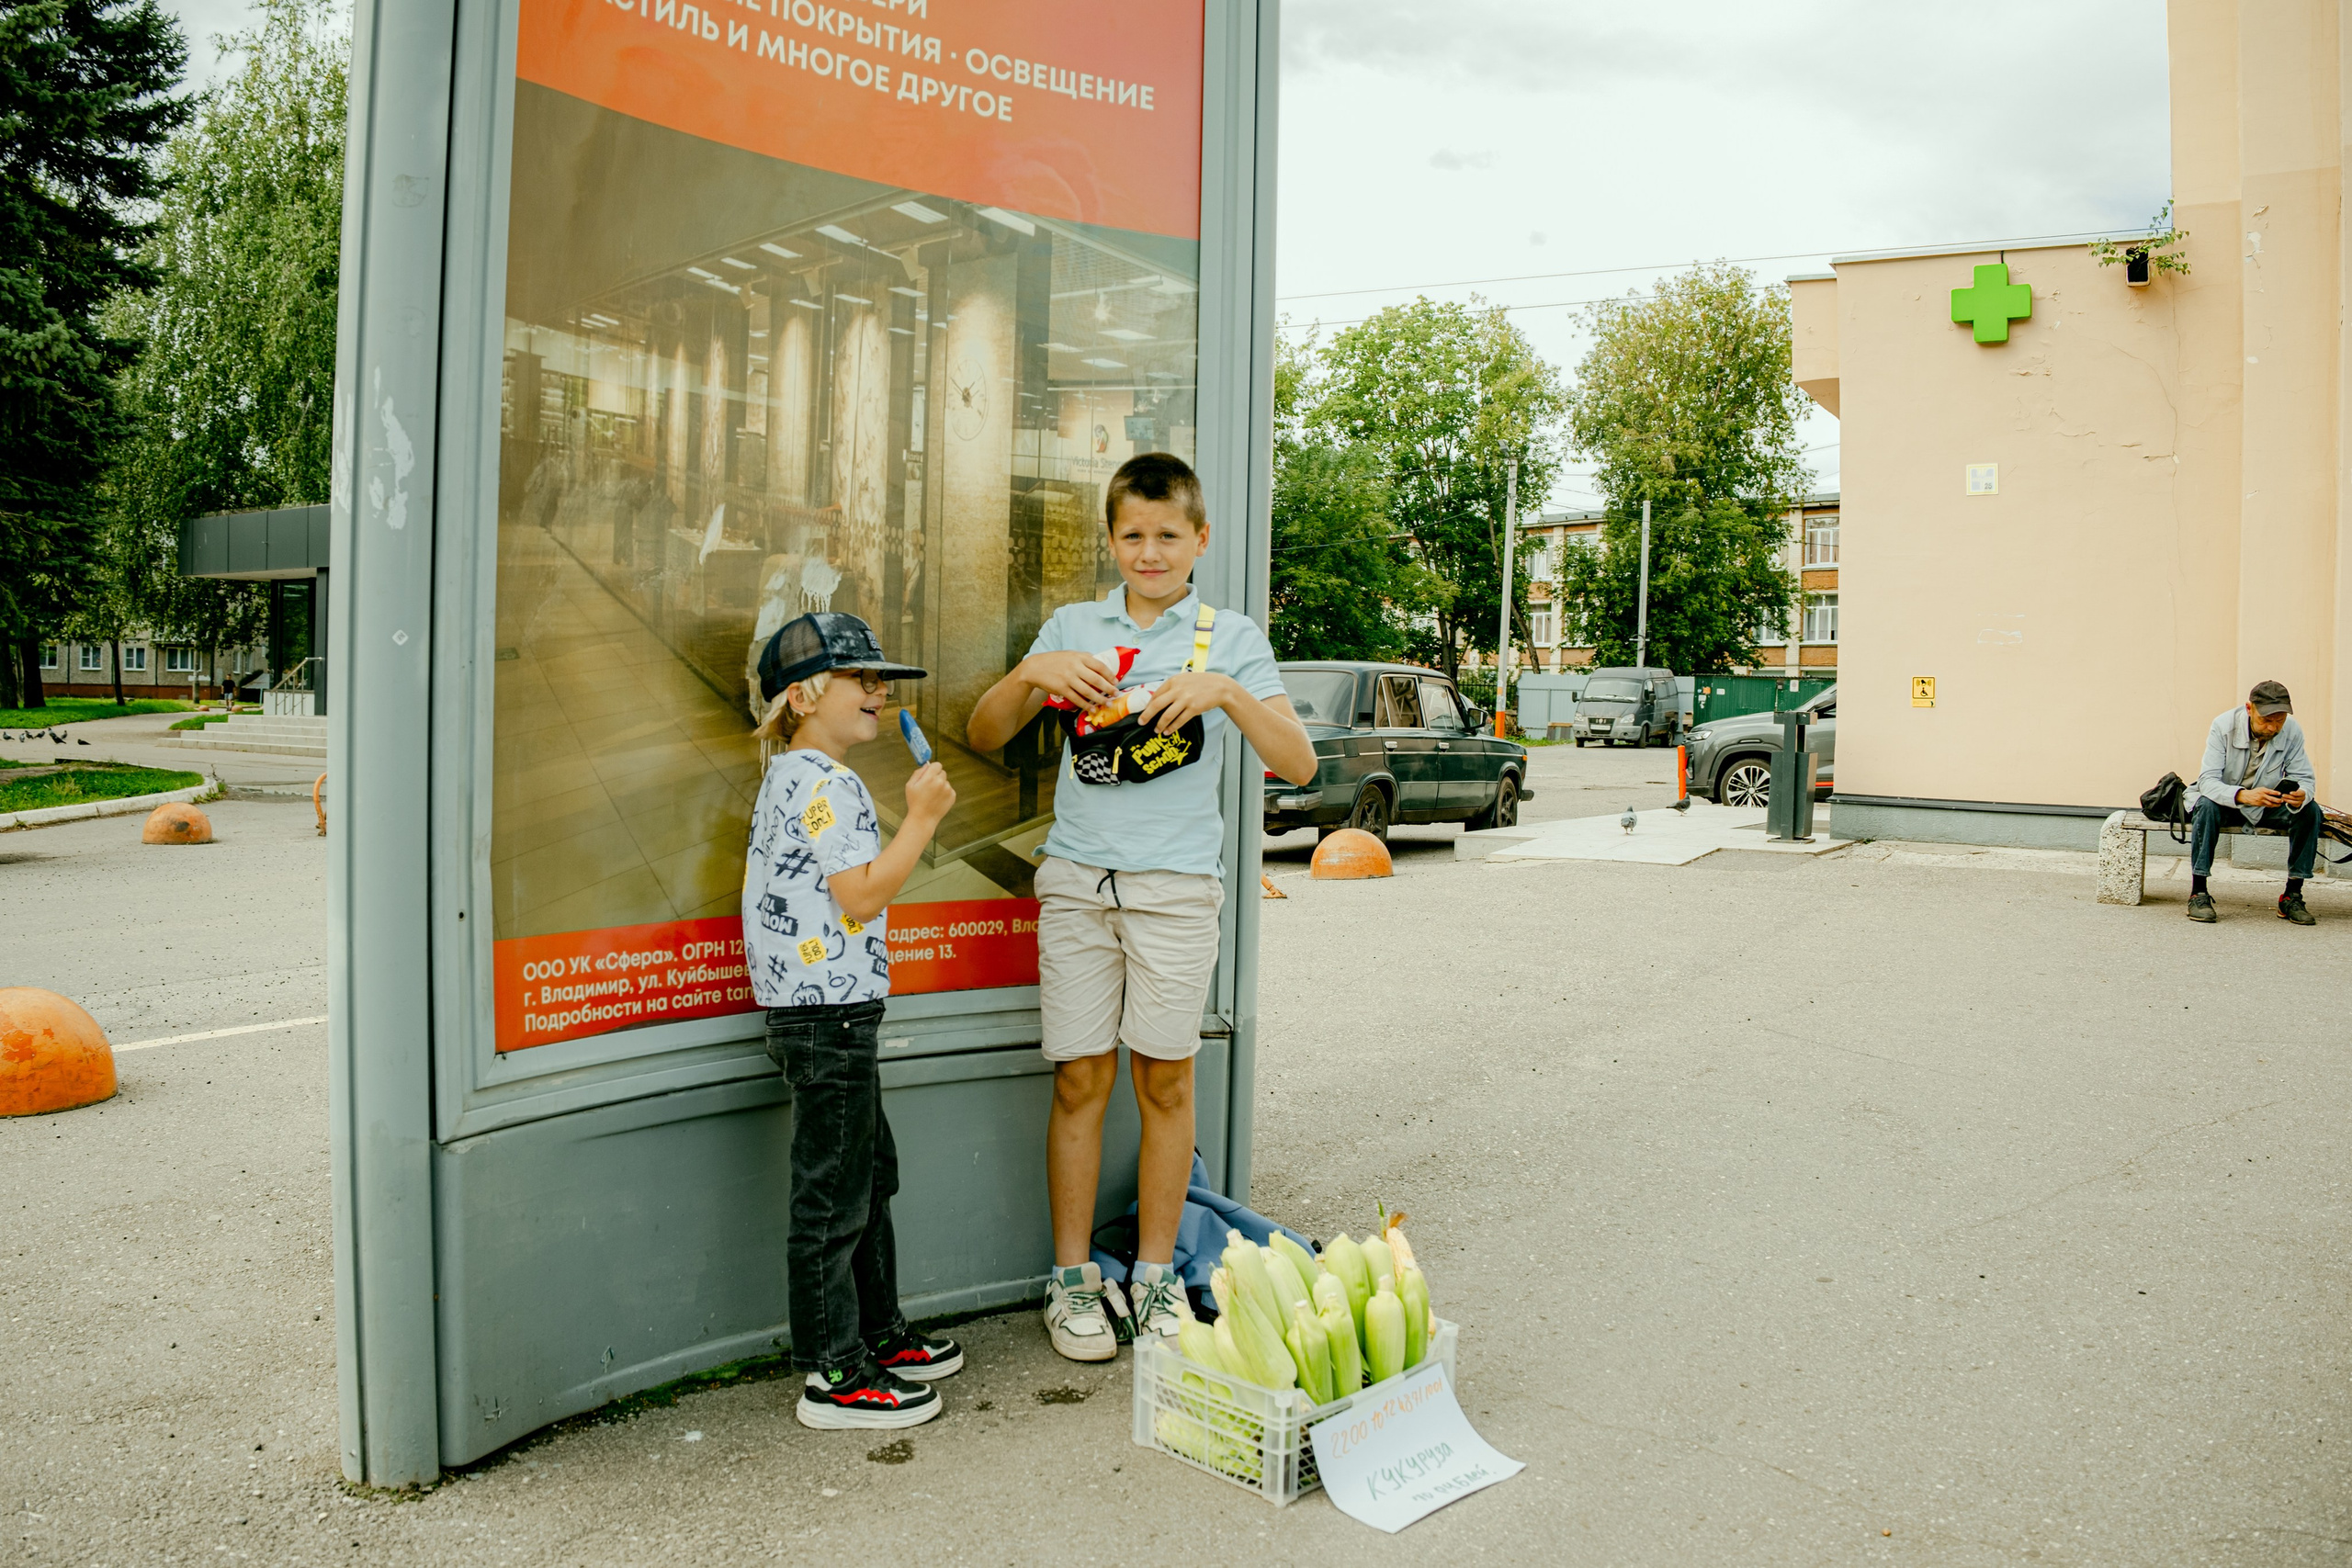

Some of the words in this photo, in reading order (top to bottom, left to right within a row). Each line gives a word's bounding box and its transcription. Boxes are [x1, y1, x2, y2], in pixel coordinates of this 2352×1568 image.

[727, 19, 749, 52] И
[756, 29, 890, 93] МНОГОЕ
[897, 71, 1012, 122] ДРУГОЕ
[965, 48, 1155, 111] ОСВЕЩЕНИЕ
[888, 925, 944, 944] адрес:
[948, 919, 1008, 938] 600029,
[938, 943, 957, 960] 13.
[523, 958, 566, 981] ООО
[569, 955, 593, 976] УК
[594, 947, 679, 971] «Сфера».
[682, 940, 725, 961] ОГРН
[524, 991, 537, 1008] г.
[540, 976, 635, 1005] Владимир,
[638, 973, 662, 994] ул.
[524, 998, 643, 1032] Подробности
[646, 995, 668, 1012] на
[672, 985, 722, 1009] сайте
